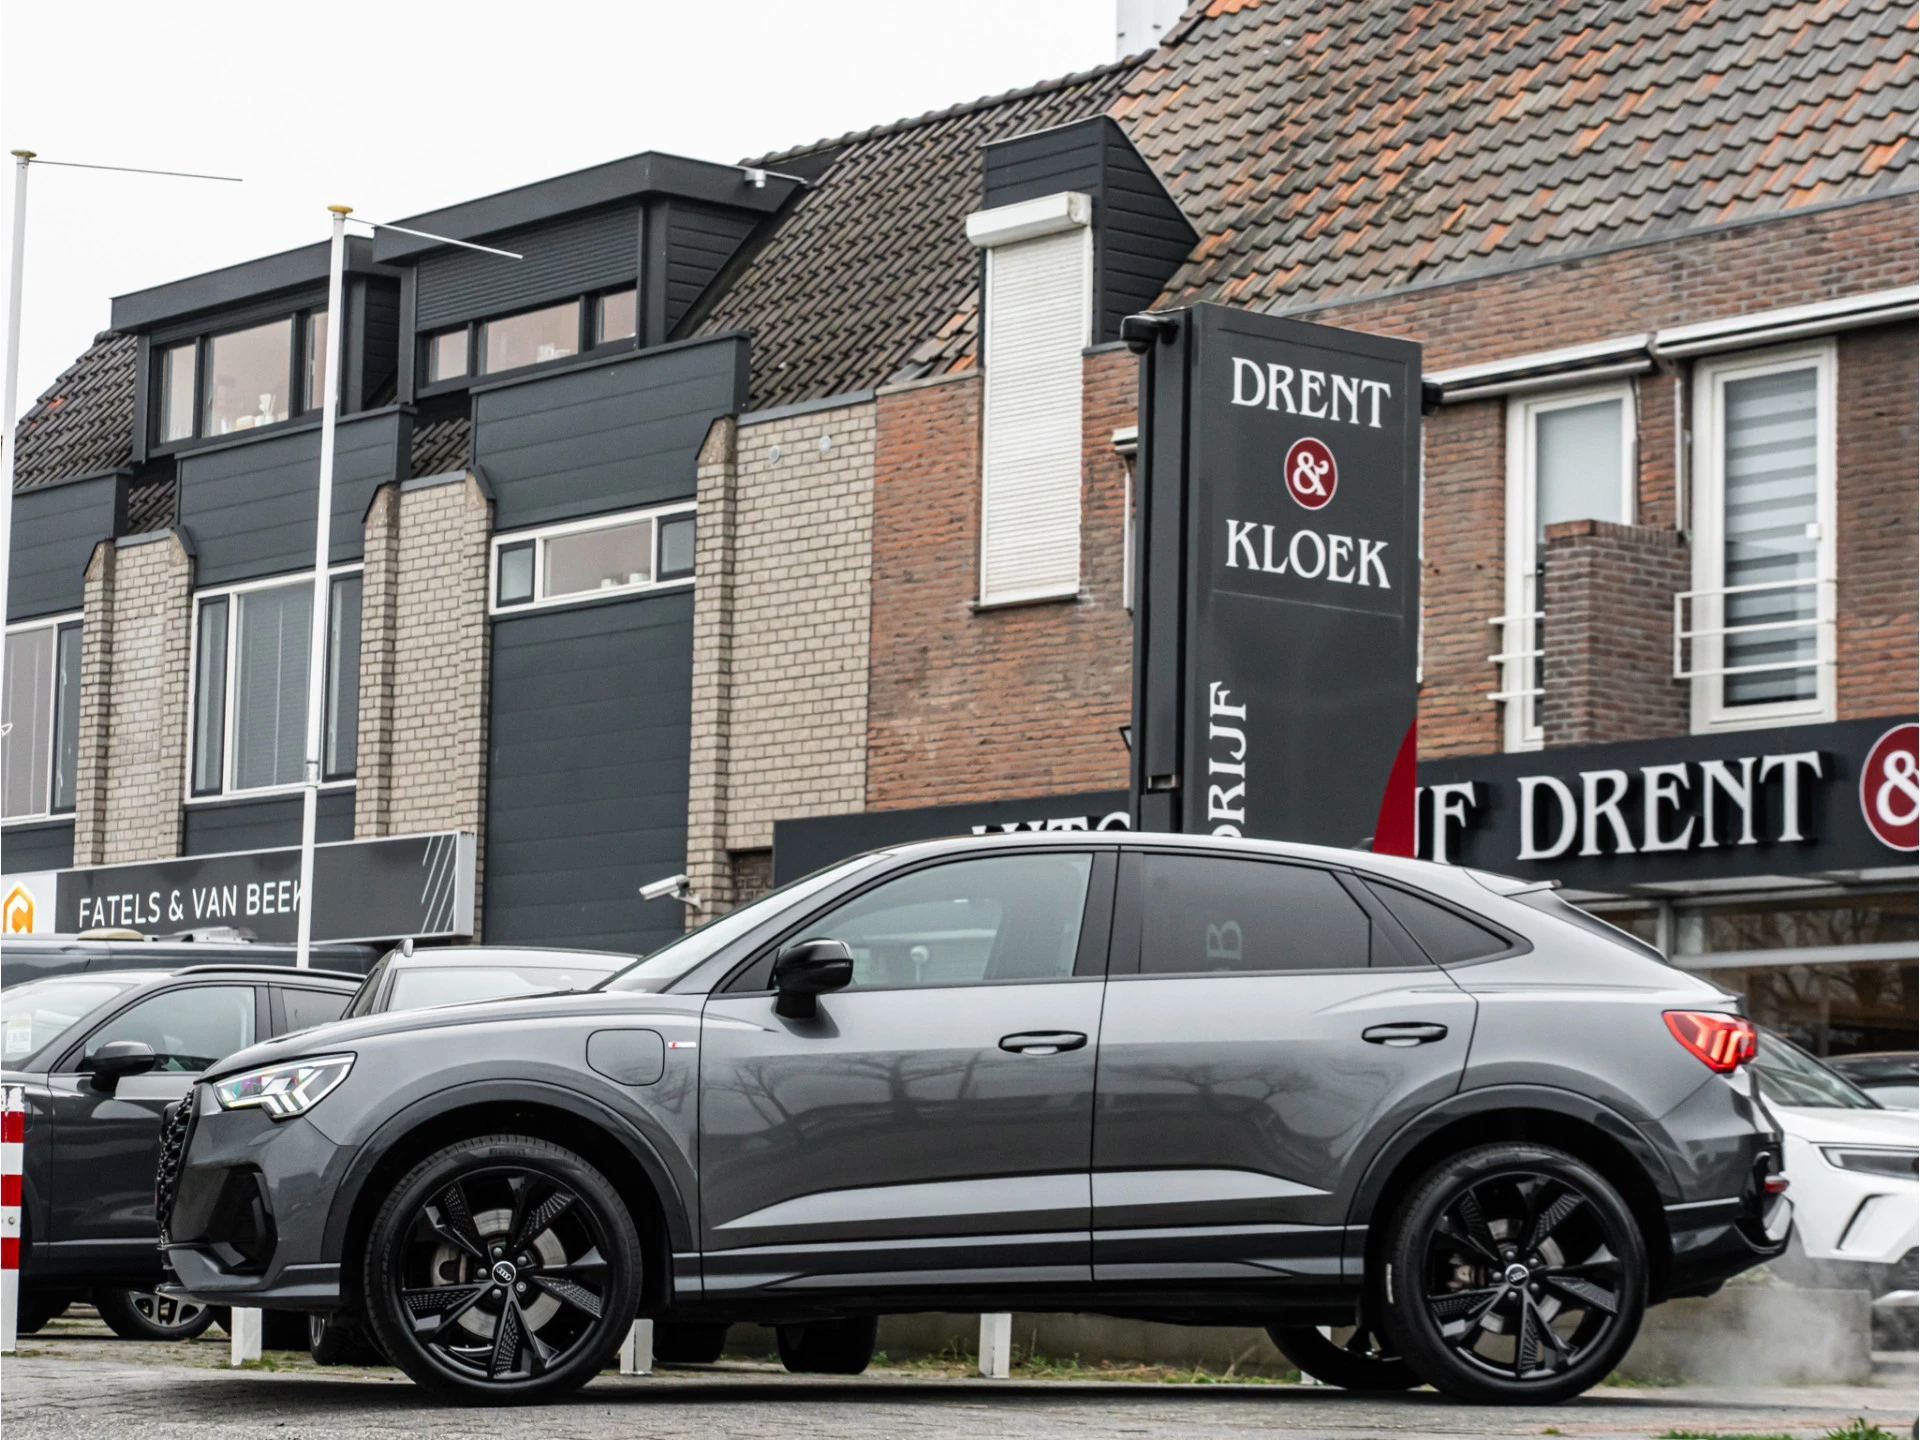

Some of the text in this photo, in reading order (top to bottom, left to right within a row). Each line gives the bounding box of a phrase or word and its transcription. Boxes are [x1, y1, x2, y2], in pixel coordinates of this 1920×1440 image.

[1231, 356, 1392, 429] DRENT
[1292, 451, 1330, 497] &
[1225, 519, 1392, 589] KLOEK
[1517, 751, 1823, 860] DRENT
[79, 891, 161, 929] FATELS
[168, 889, 184, 921] &
[192, 885, 237, 919] VAN
